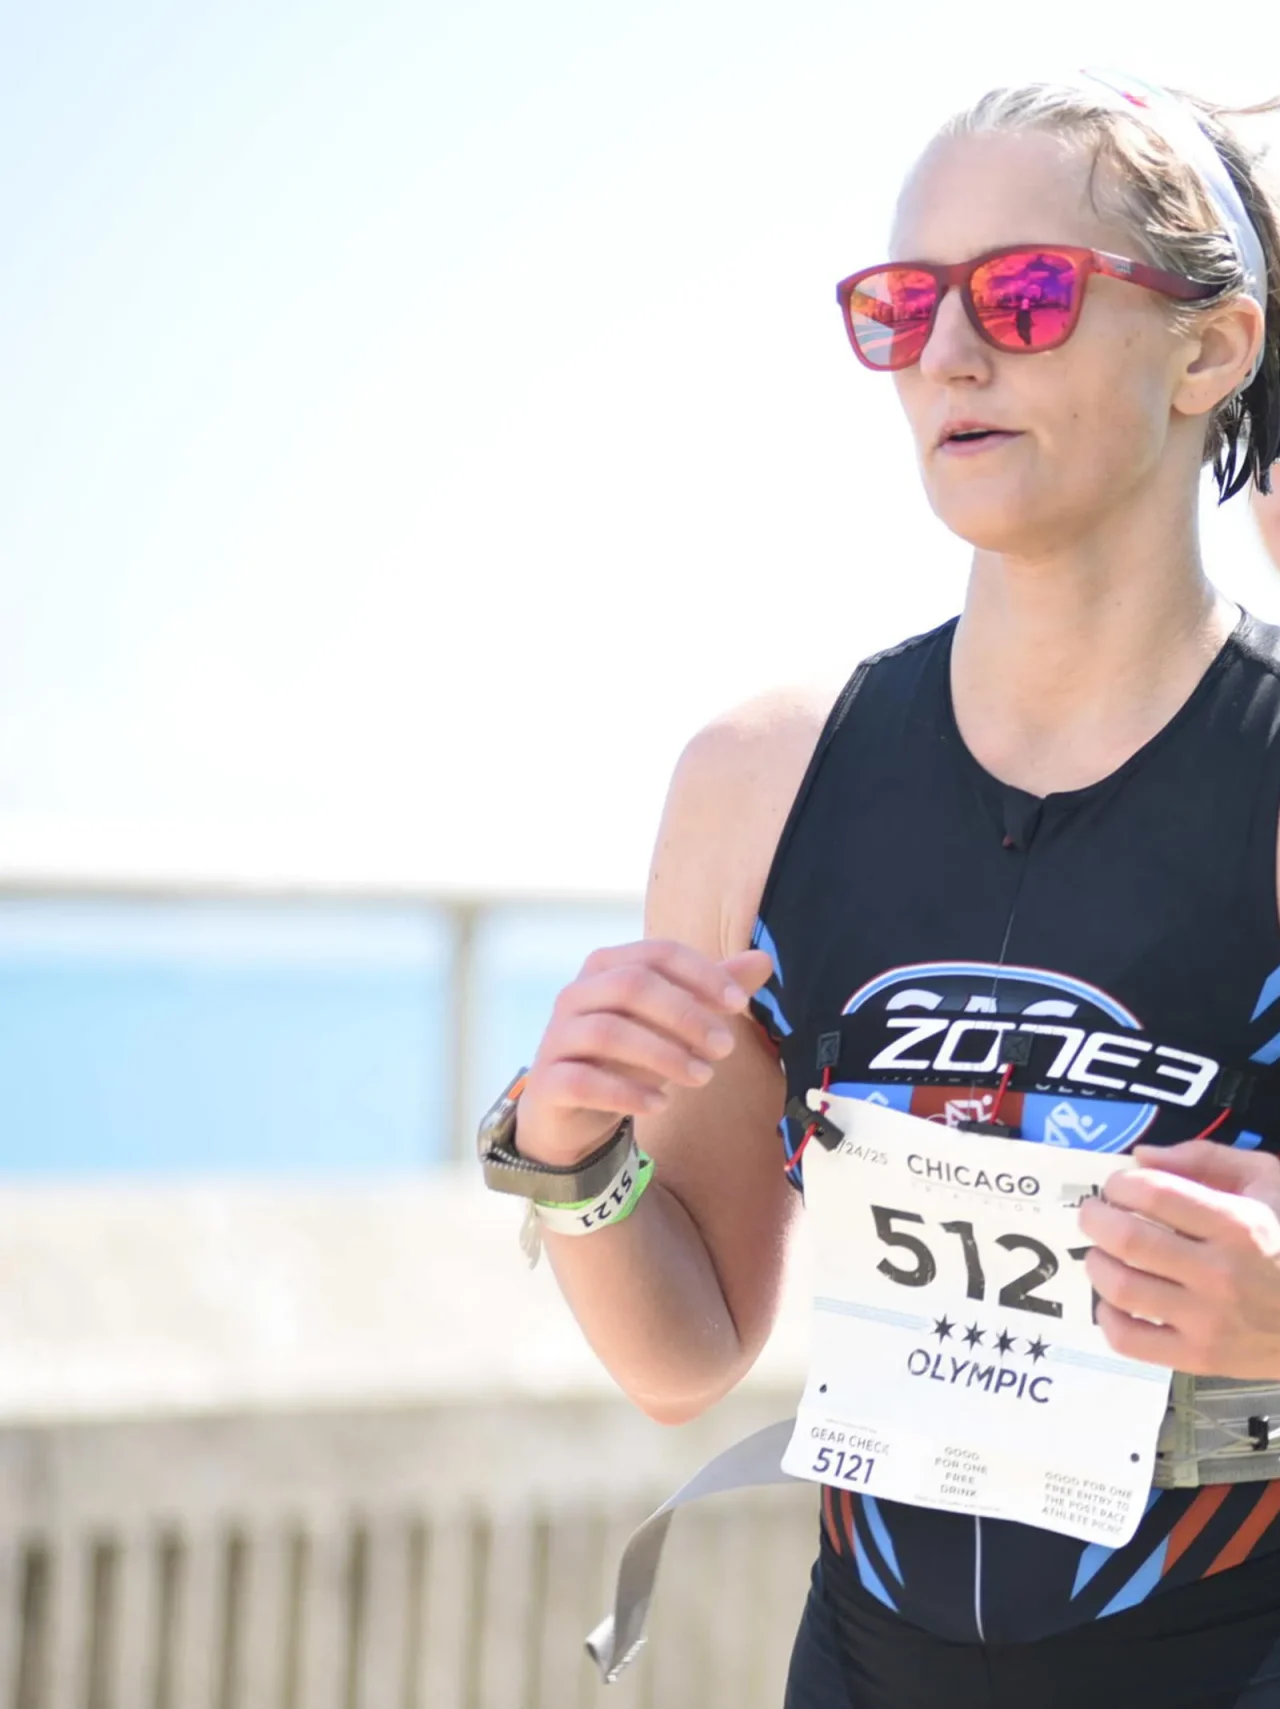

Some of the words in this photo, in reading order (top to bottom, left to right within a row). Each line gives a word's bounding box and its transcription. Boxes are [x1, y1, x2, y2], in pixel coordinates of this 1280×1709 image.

[906, 1153, 1041, 1197] CHICAGO
[579, 1170, 633, 1228] 5121
[907, 1348, 1054, 1404] OLYMPIC
[810, 1426, 845, 1445] GEAR
[944, 1446, 980, 1461] GOOD
[812, 1446, 876, 1485] 5121
[934, 1457, 959, 1470] FOR
[962, 1462, 988, 1475] ONE
[944, 1472, 976, 1485] FREE
[1044, 1471, 1080, 1486] GOOD
[1083, 1480, 1106, 1492] FOR
[1109, 1486, 1133, 1499] ONE
[940, 1484, 978, 1498] DRINK
[1044, 1482, 1072, 1496] FREE
[1076, 1490, 1113, 1506] ENTRY
[1068, 1500, 1097, 1516] POST
